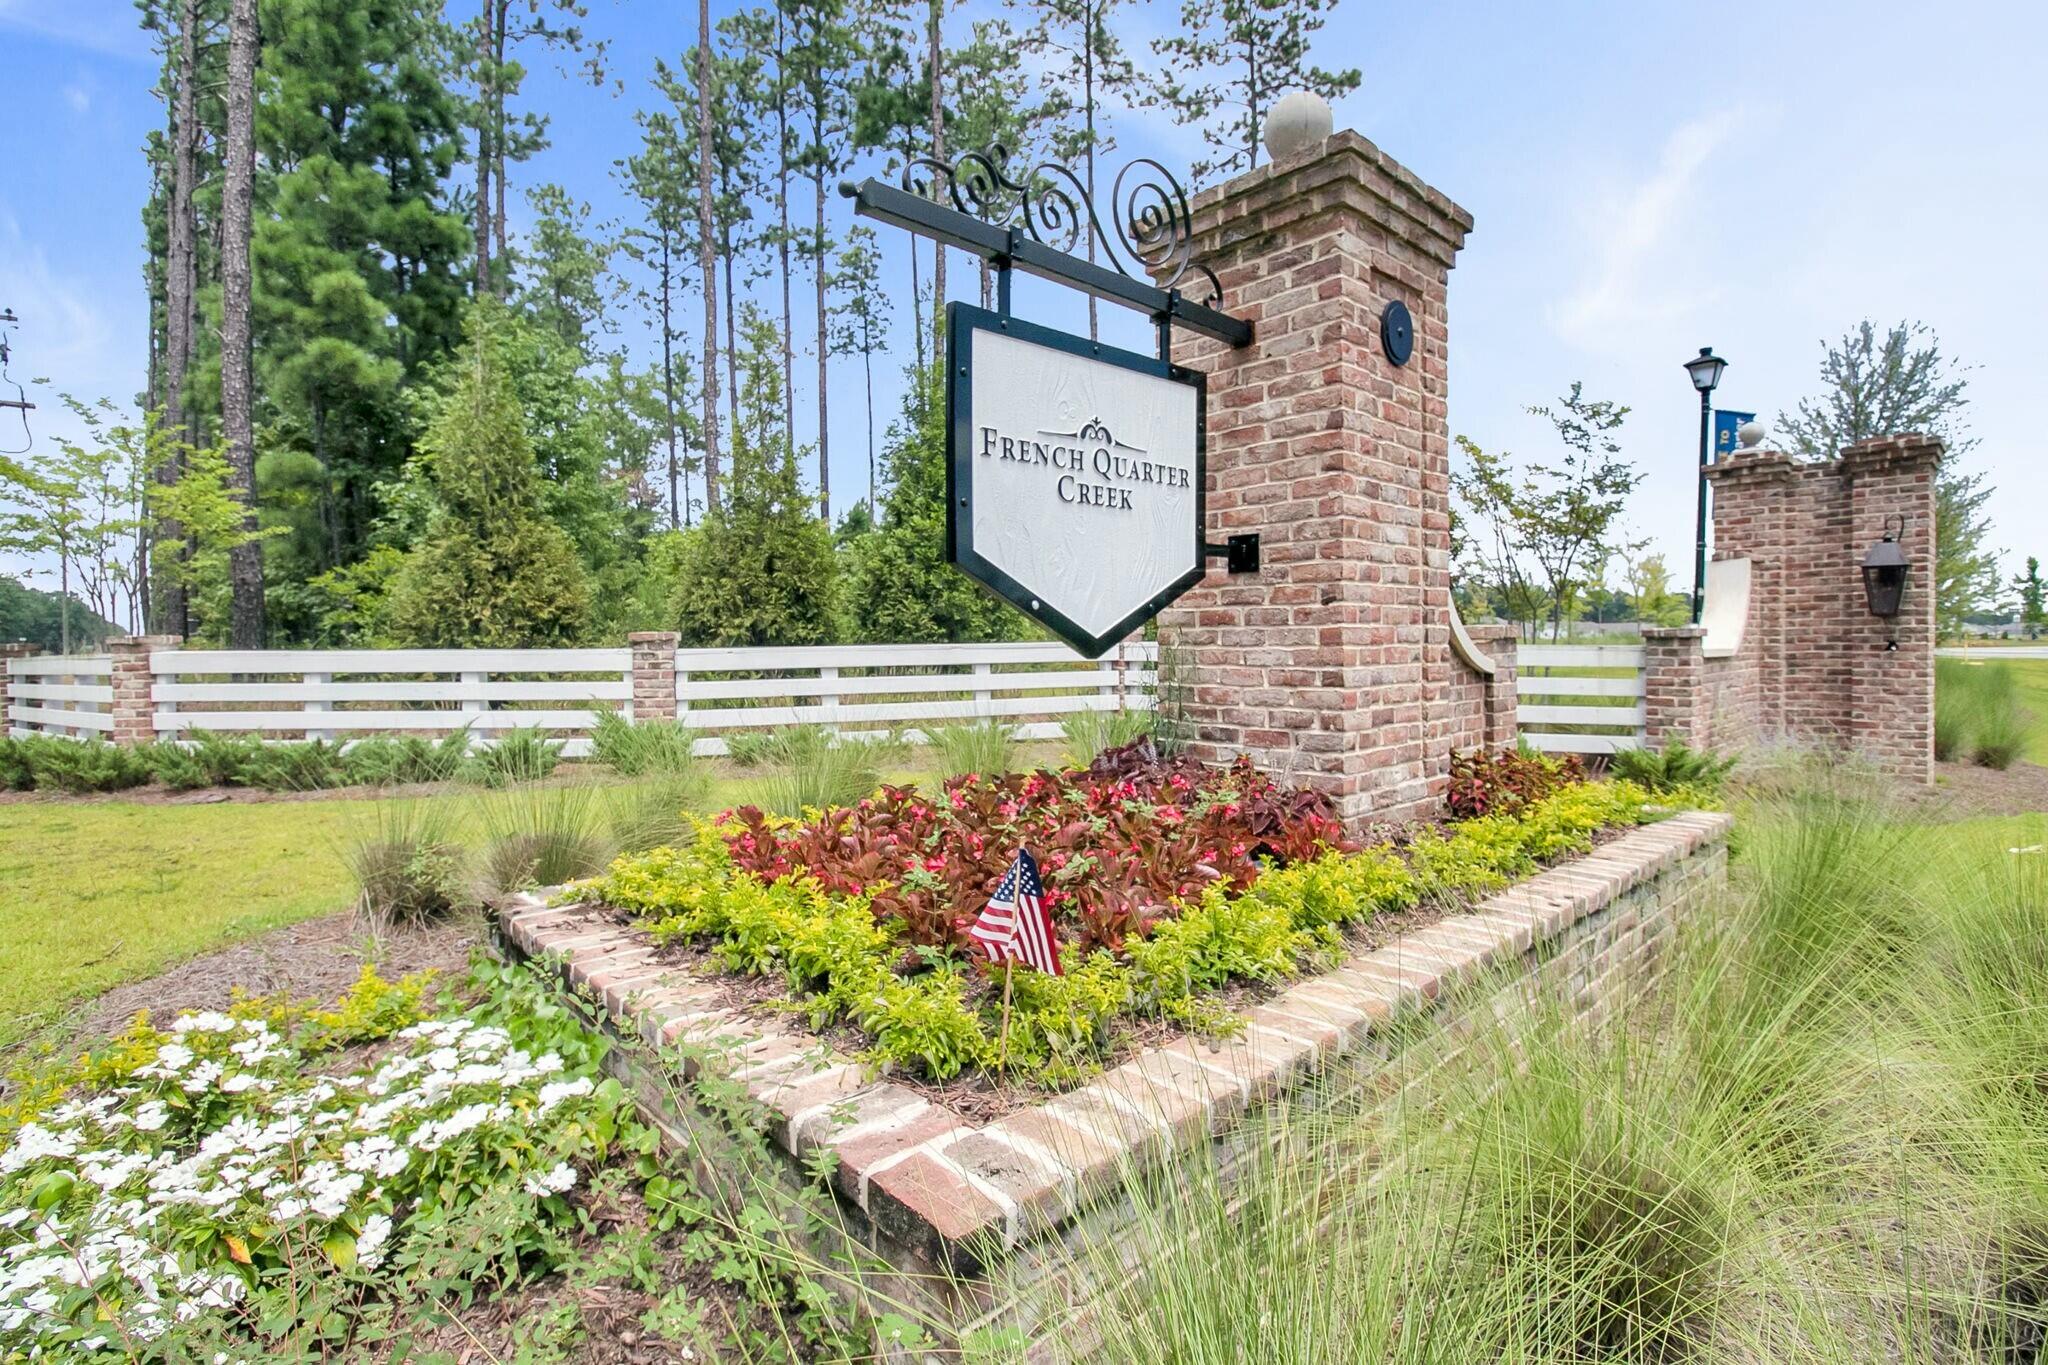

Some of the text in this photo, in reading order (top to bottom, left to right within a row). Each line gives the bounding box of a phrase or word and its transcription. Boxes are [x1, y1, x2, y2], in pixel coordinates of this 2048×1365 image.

[980, 426, 1190, 488] FRENCH QUARTER
[1057, 475, 1133, 510] CREEK
